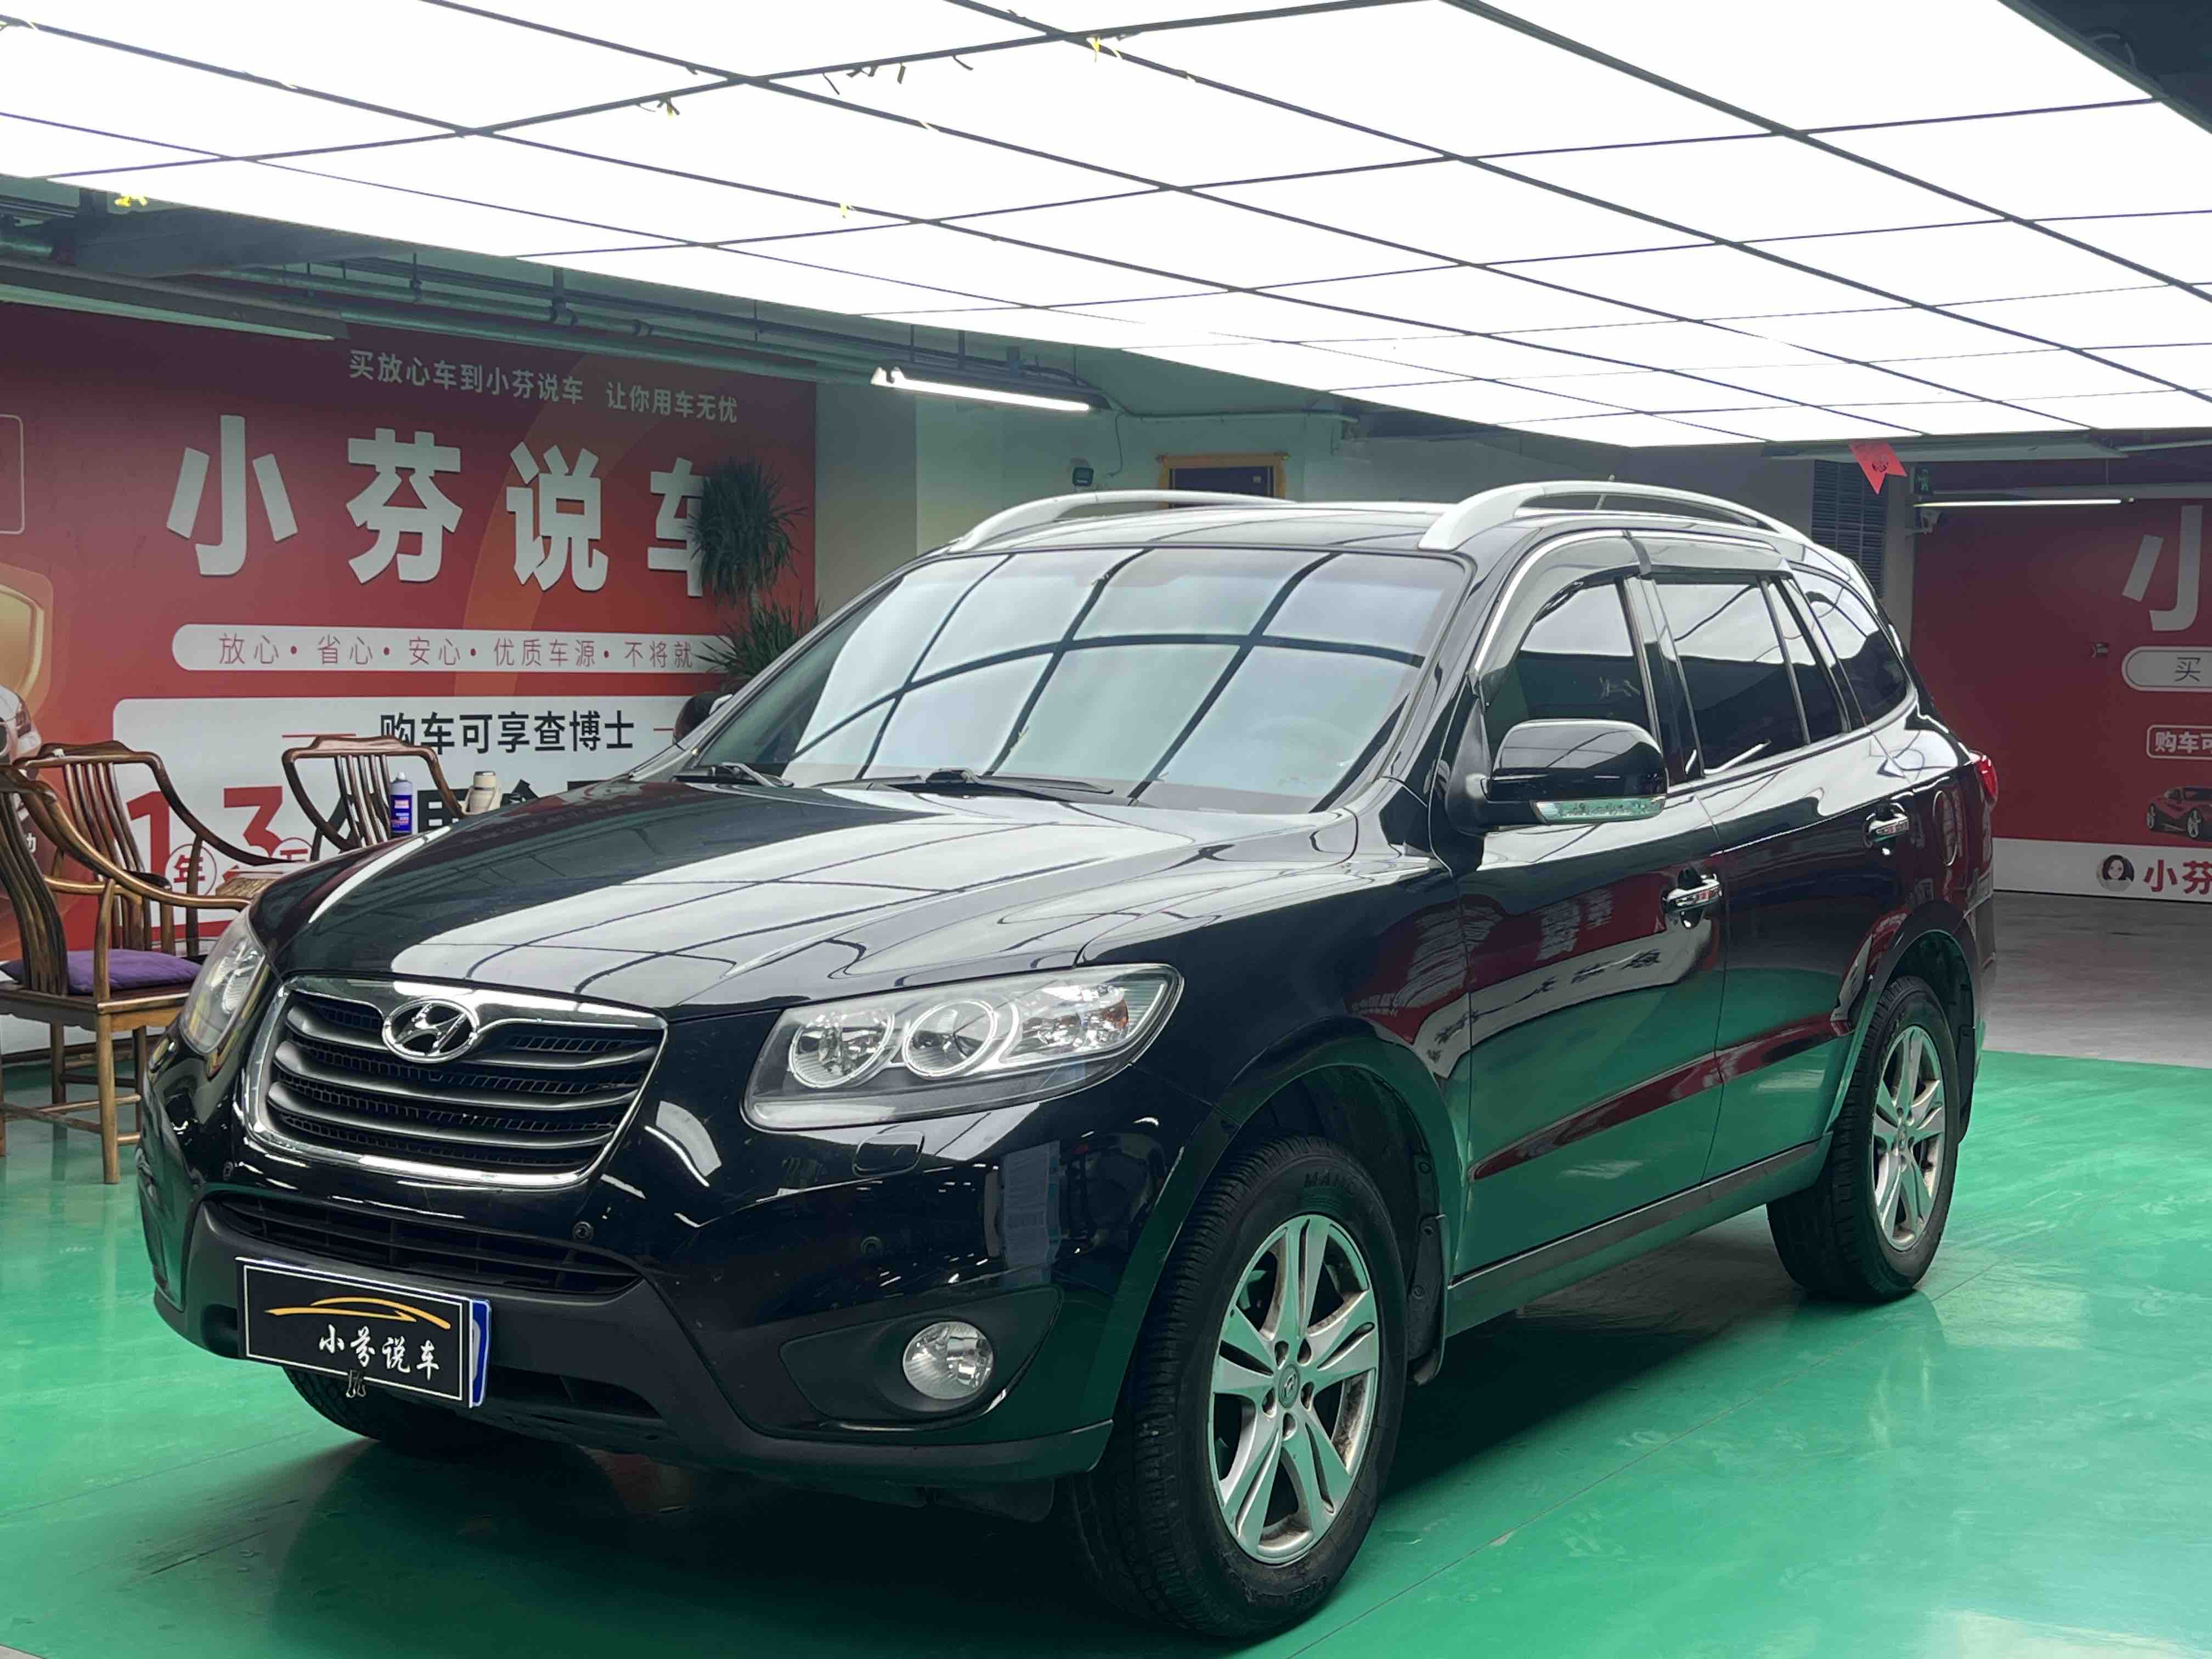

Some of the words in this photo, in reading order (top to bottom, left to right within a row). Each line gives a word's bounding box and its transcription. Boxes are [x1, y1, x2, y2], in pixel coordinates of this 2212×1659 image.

[349, 349, 584, 404] 买放心车到小芬说车
[606, 382, 738, 423] 让你用车无忧
[2175, 657, 2201, 682] 买
[381, 710, 635, 756] 购车可享查博士
[2143, 859, 2212, 895] 小芬
[319, 1324, 439, 1381] 小芬说车
